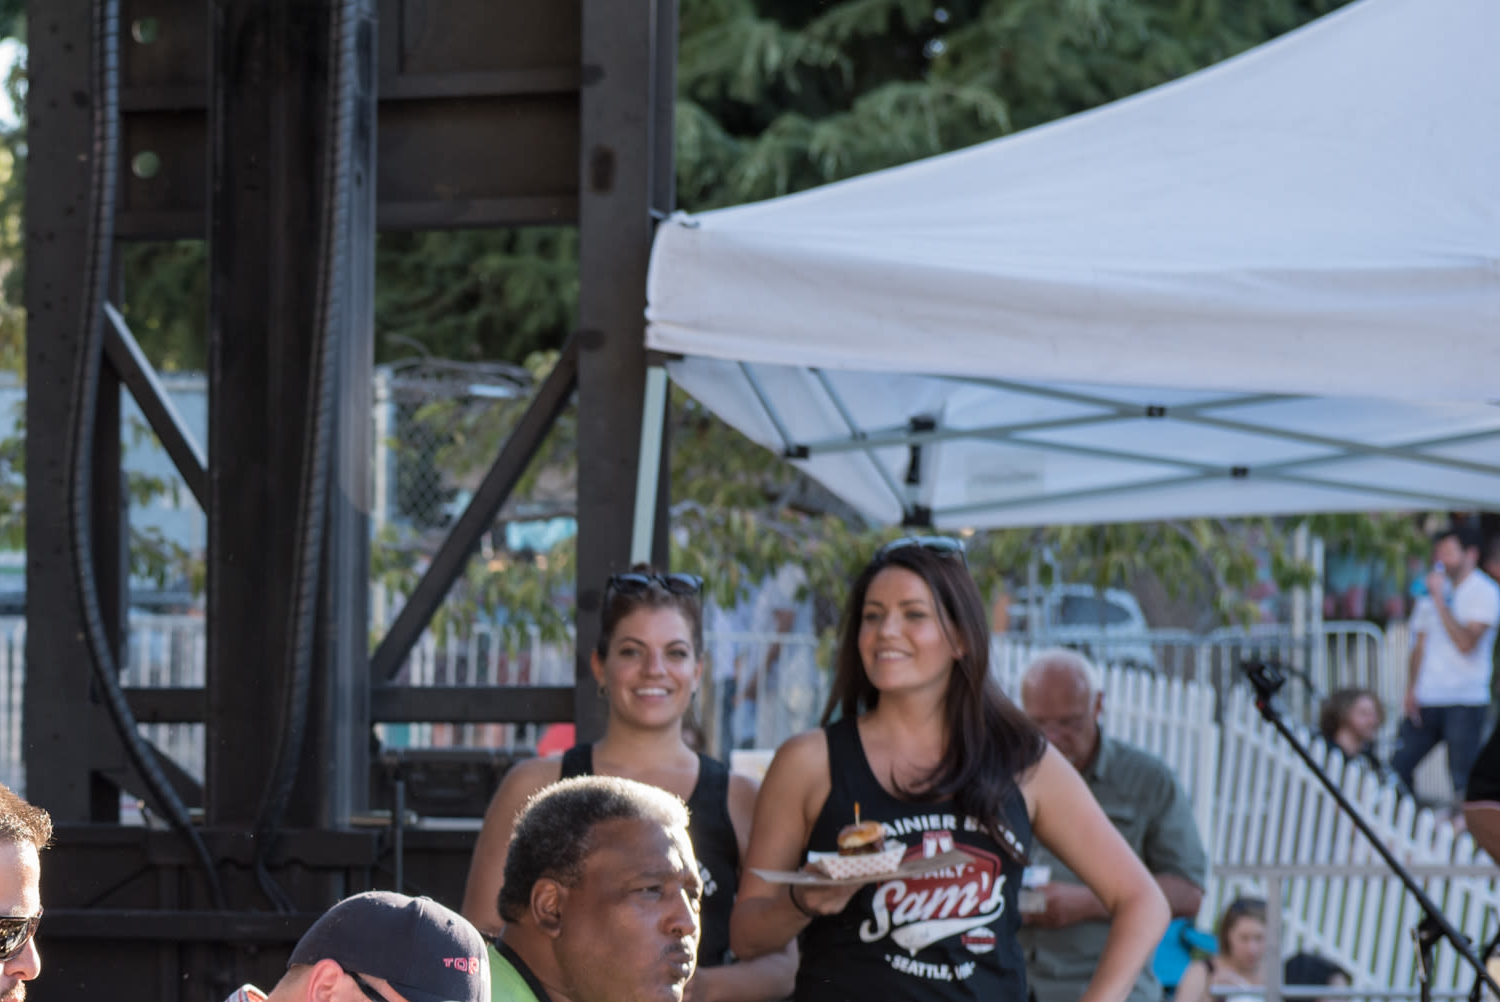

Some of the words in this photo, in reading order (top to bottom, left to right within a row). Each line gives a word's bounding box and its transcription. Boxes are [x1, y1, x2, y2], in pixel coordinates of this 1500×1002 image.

[882, 814, 957, 838] AINIER
[859, 872, 1007, 943] Sam's
[891, 953, 953, 982] SEATTLE,
